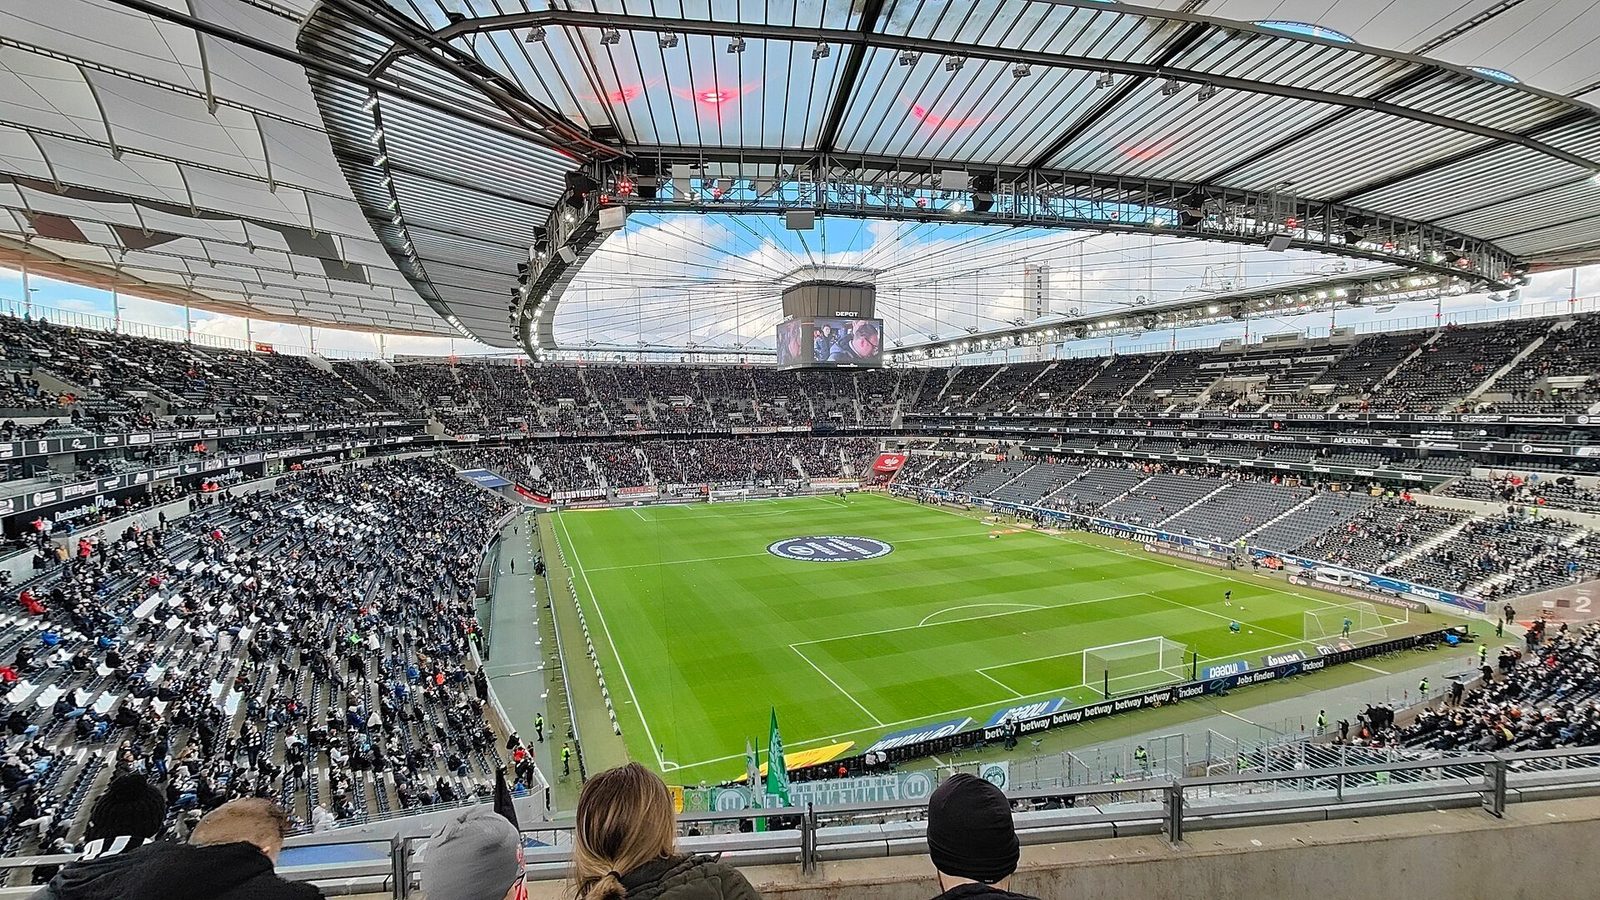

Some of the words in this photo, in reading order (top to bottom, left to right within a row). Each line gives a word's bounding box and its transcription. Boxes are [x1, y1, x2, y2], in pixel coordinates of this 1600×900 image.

[1414, 414, 1433, 422] Lupus
[1434, 414, 1452, 422] alpha
[55, 507, 81, 522] Deutsche
[1168, 548, 1179, 556] APP
[1197, 553, 1228, 567] EINTRACHT
[1311, 580, 1324, 589] DIE
[1324, 583, 1340, 592] APP
[1341, 586, 1370, 599] DEINER
[1370, 593, 1420, 609] EINTRACHT
[1411, 587, 1440, 601] indeed
[1575, 596, 1592, 613] 2
[1179, 685, 1204, 698] indeed
[1236, 676, 1253, 686] Jobs
[1254, 671, 1275, 682] finden
[1302, 659, 1324, 671] indeed
[1020, 718, 1051, 733] betway
[1053, 711, 1083, 725] betway
[1084, 703, 1113, 717] betway
[1114, 697, 1142, 711] betway
[1144, 691, 1171, 705] betway
